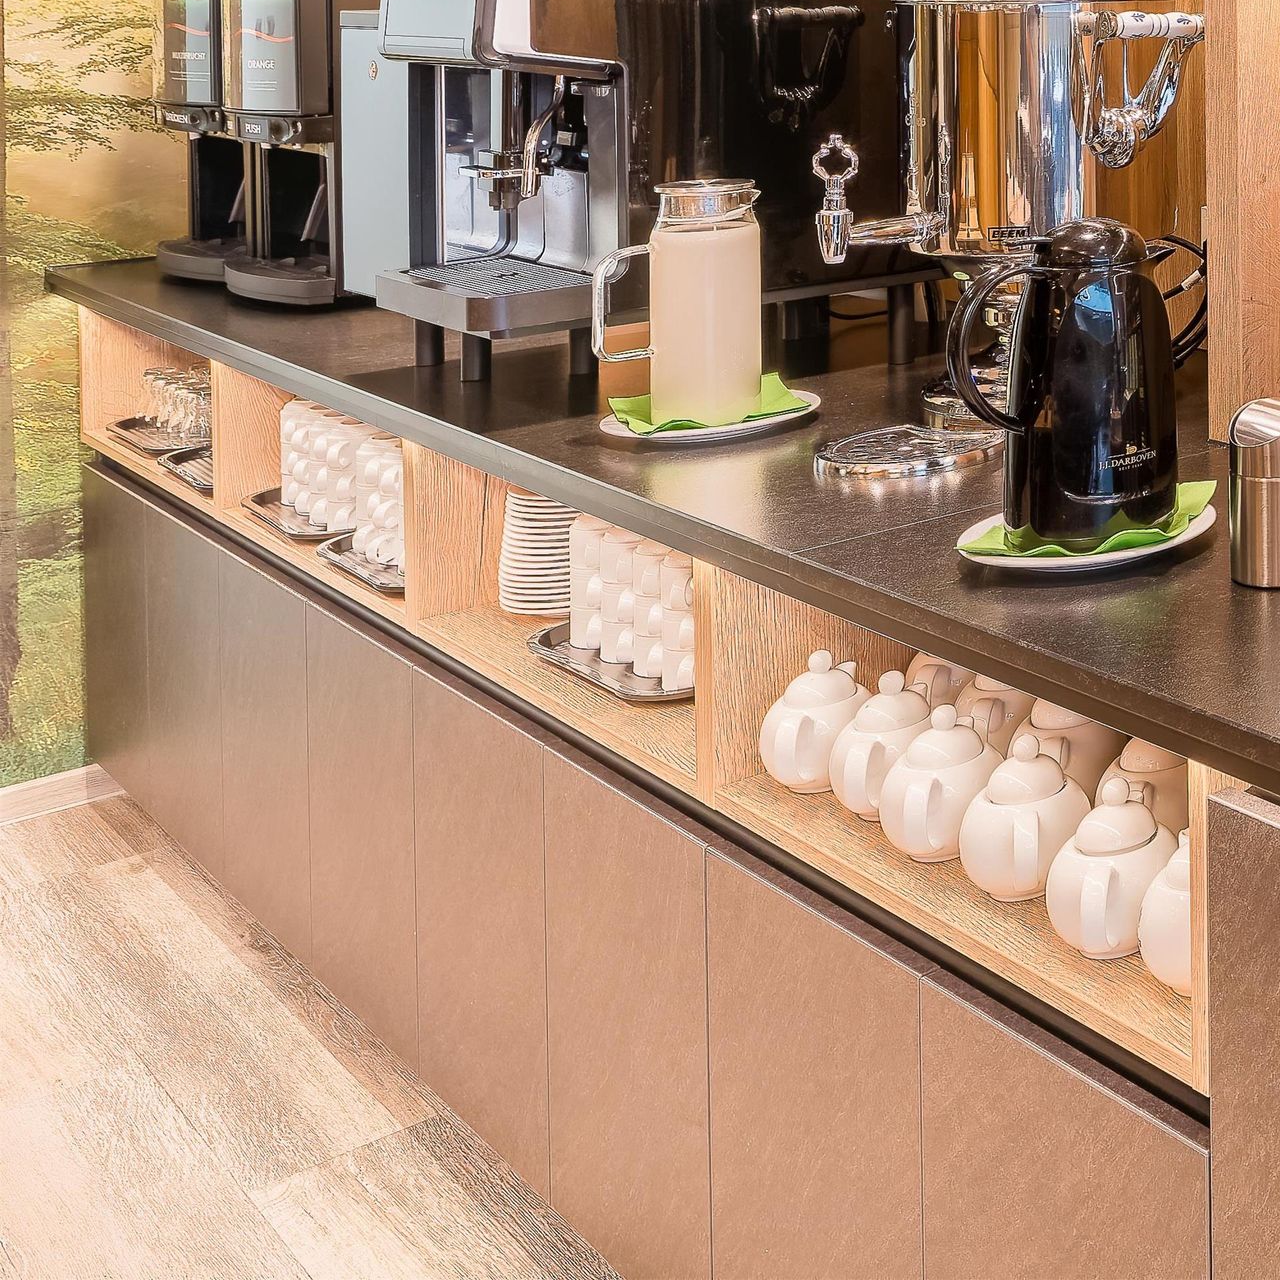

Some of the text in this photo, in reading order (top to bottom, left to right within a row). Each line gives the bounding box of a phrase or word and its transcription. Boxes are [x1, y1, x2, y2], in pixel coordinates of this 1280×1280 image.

[247, 60, 276, 70] ORANGE
[245, 123, 261, 134] PUSH
[991, 228, 1026, 239] BEEM
